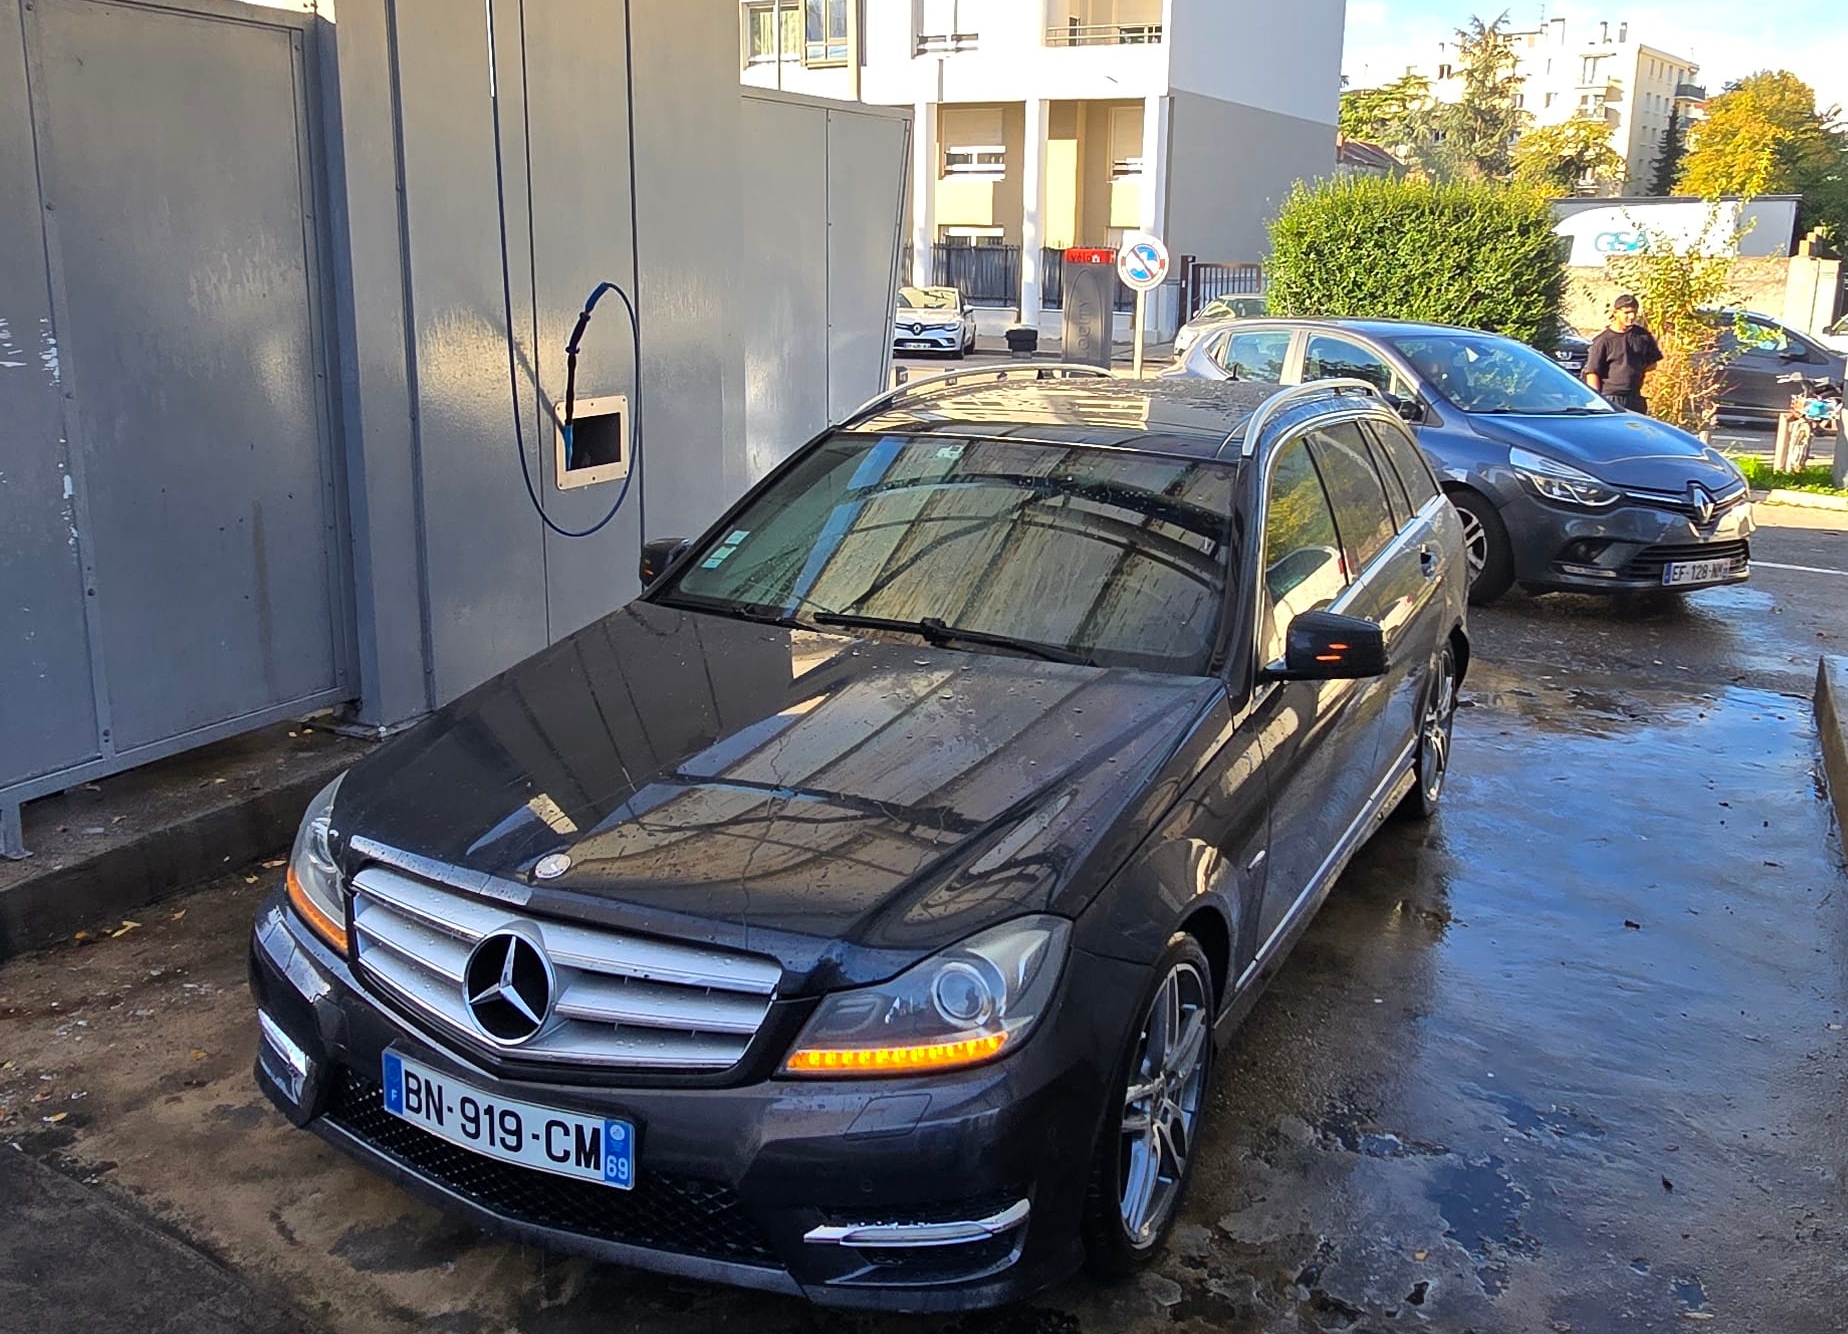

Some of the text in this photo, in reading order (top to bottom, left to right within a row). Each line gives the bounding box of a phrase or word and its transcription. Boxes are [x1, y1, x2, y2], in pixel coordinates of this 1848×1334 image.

[391, 1088, 398, 1101] F
[404, 1069, 601, 1171] BN-919-CM
[607, 1155, 628, 1180] 69
